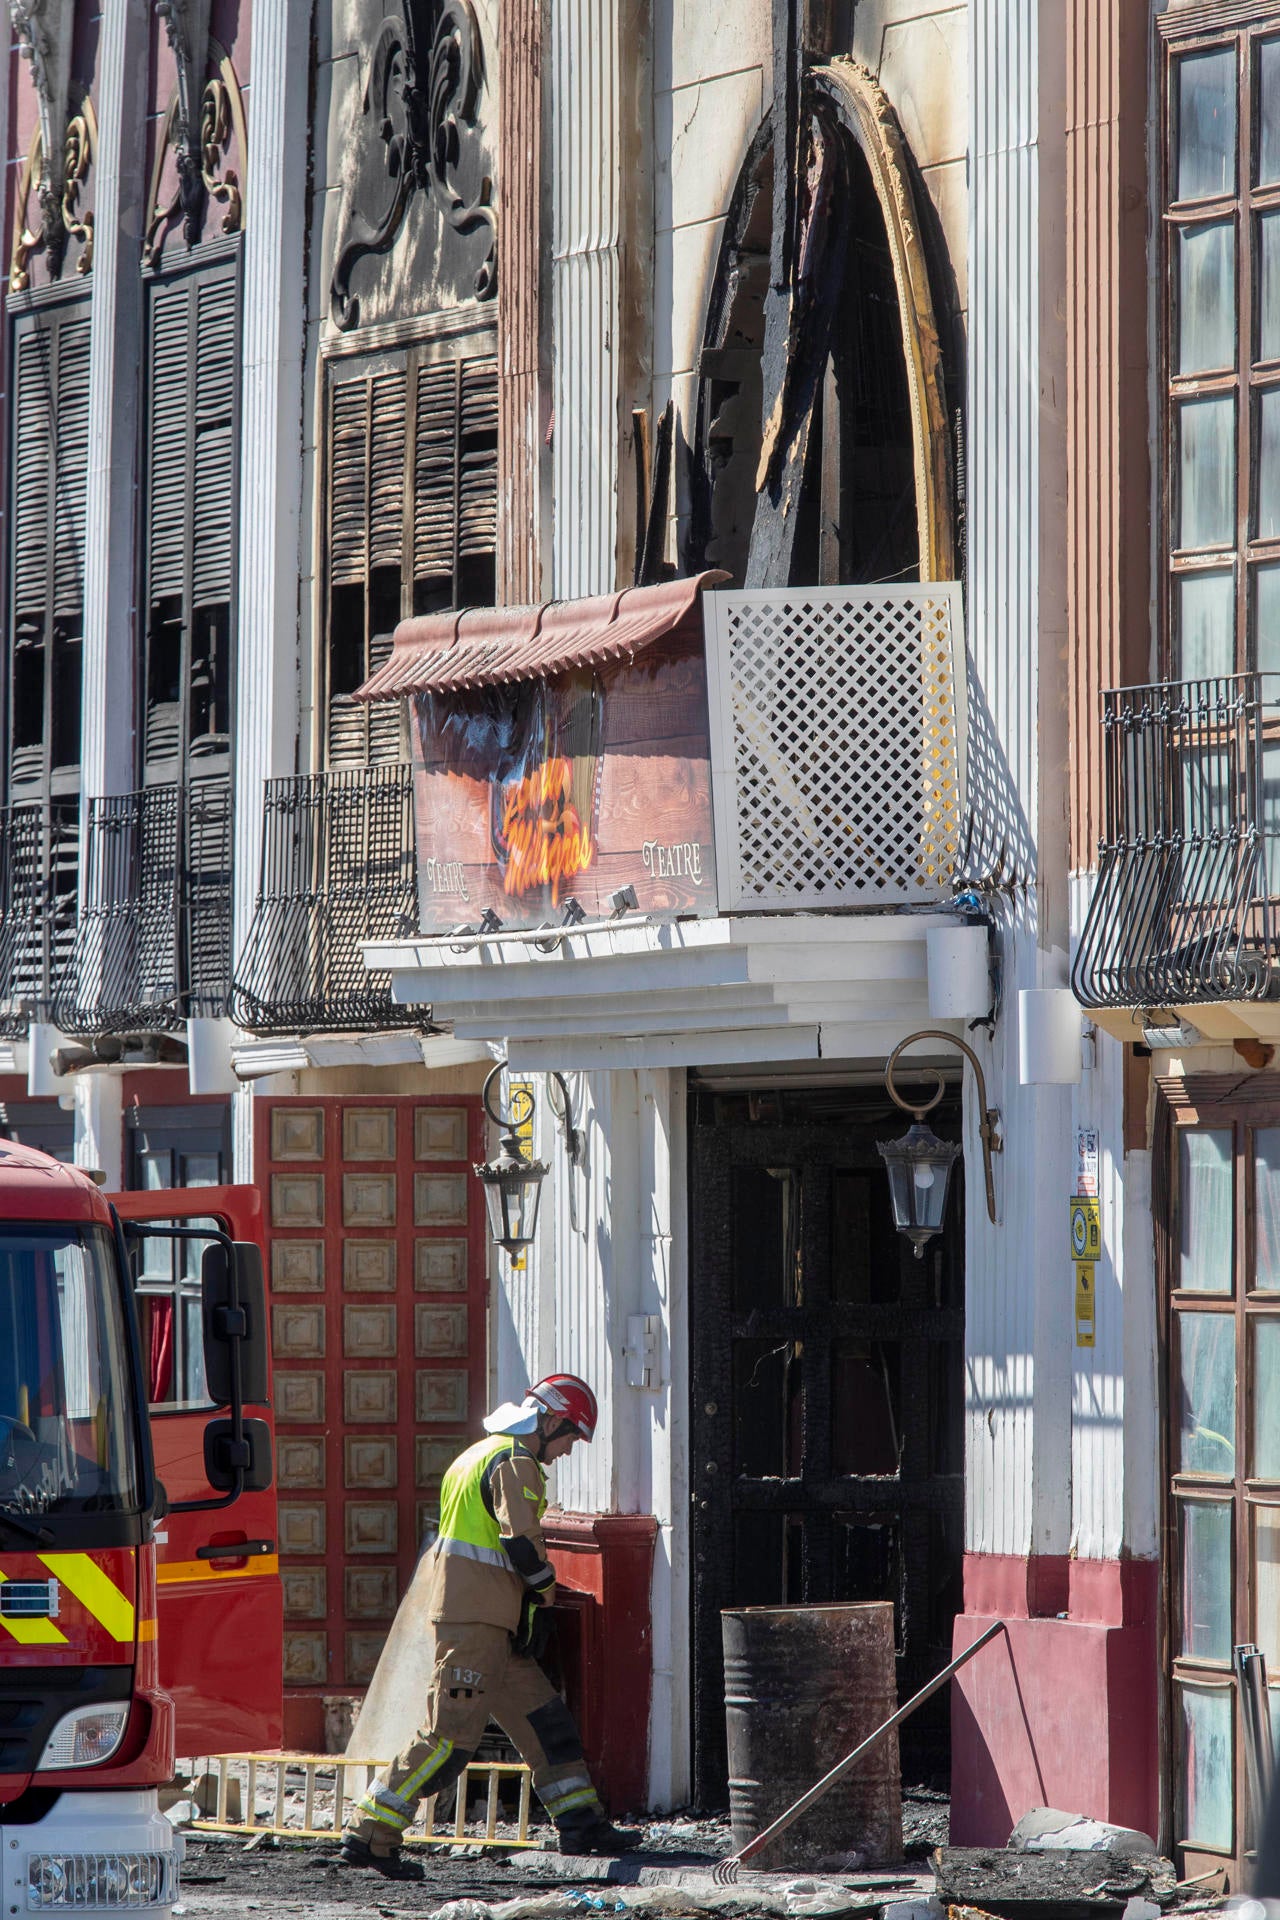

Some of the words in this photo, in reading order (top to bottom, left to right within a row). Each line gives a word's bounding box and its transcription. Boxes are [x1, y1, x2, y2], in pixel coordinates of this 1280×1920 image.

[426, 857, 470, 902] TEATRE
[641, 839, 703, 886] TEATRE
[453, 1667, 482, 1687] 137
